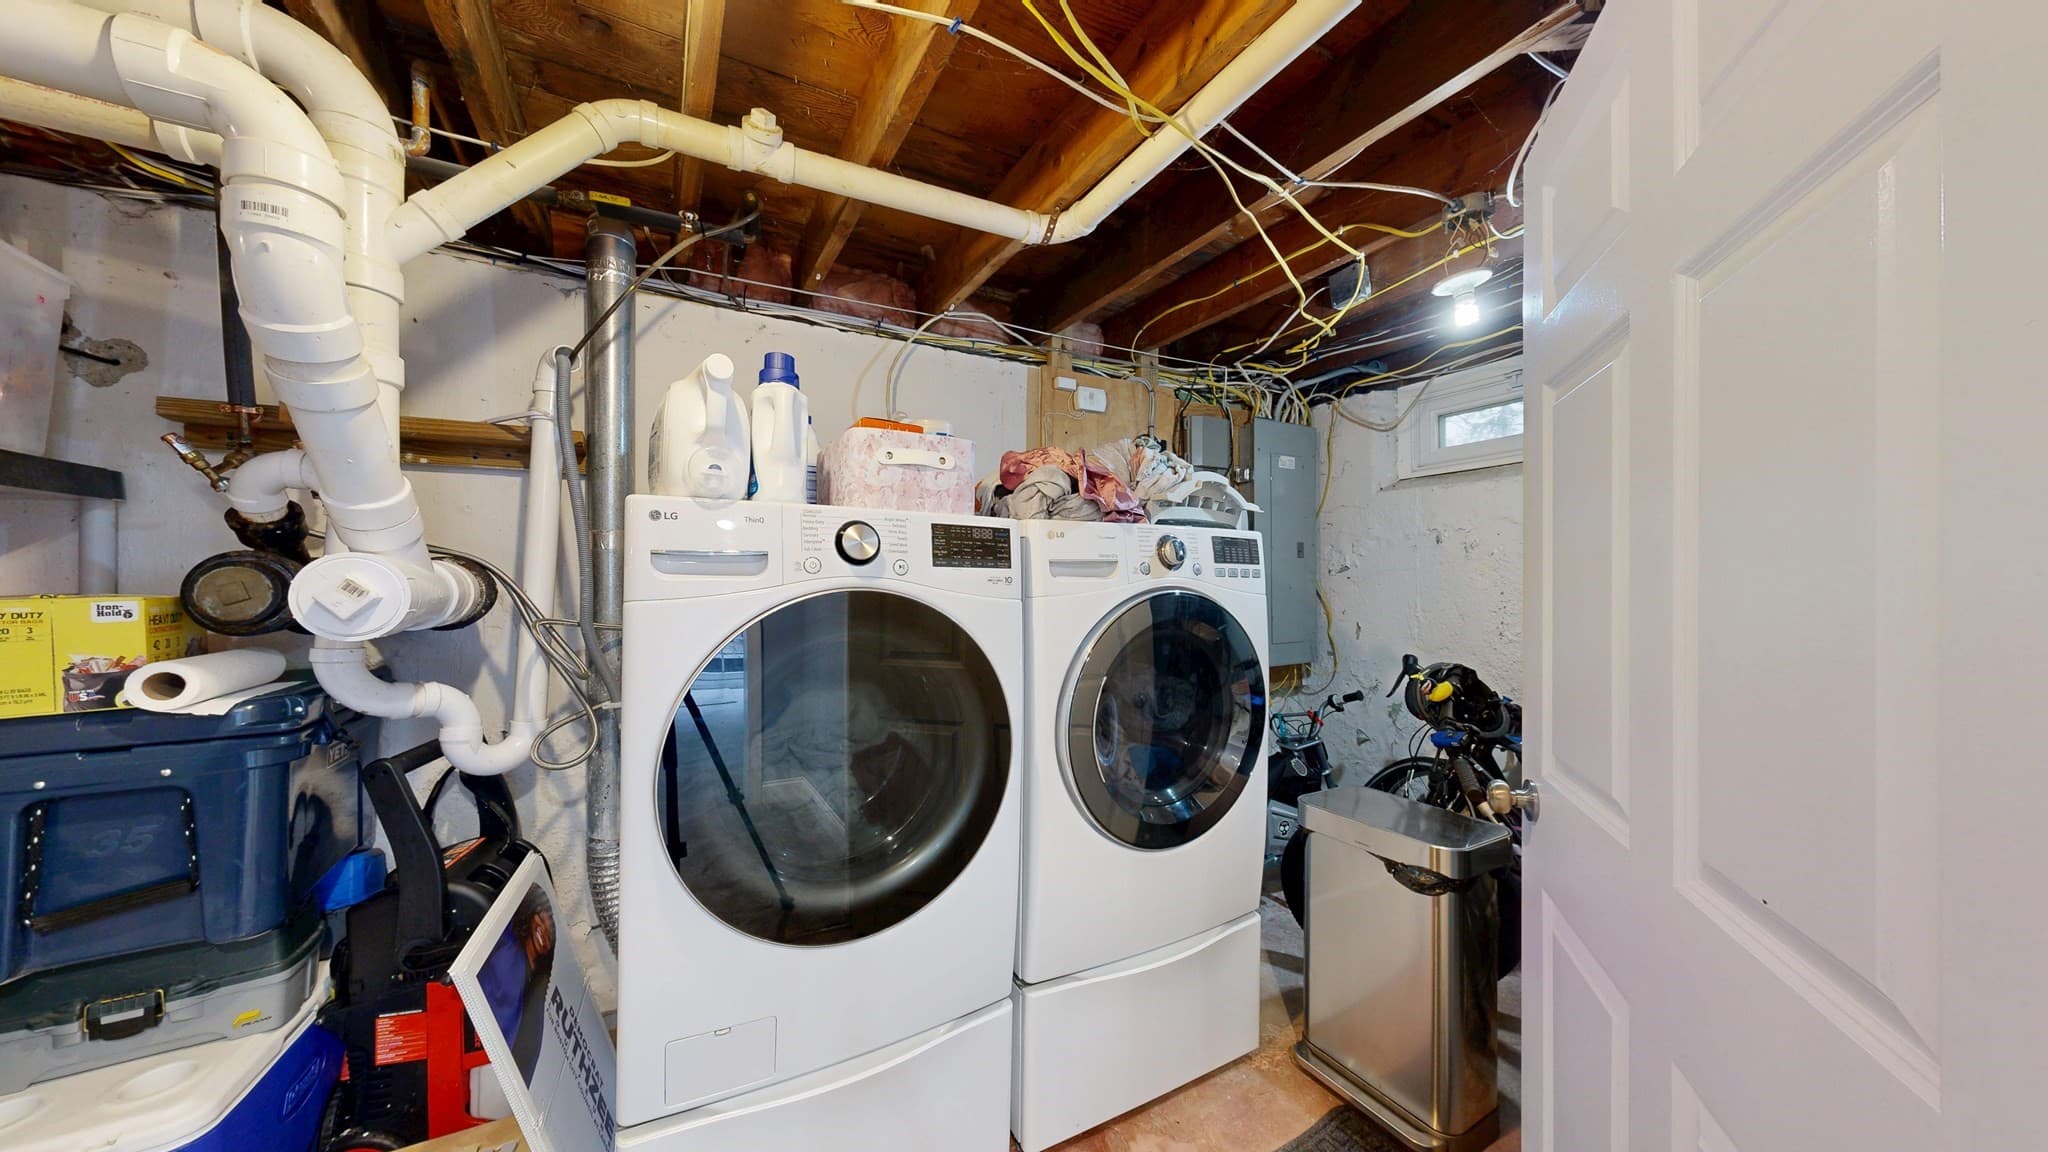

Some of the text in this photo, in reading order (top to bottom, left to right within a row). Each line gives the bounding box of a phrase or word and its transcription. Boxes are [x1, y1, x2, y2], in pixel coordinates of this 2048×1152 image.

[664, 511, 679, 521] LG
[744, 515, 765, 524] ThinQ
[11, 612, 44, 620] DUTY
[570, 1006, 603, 1088] DEMOCRAT
[551, 985, 615, 1142] RUTHZEE
